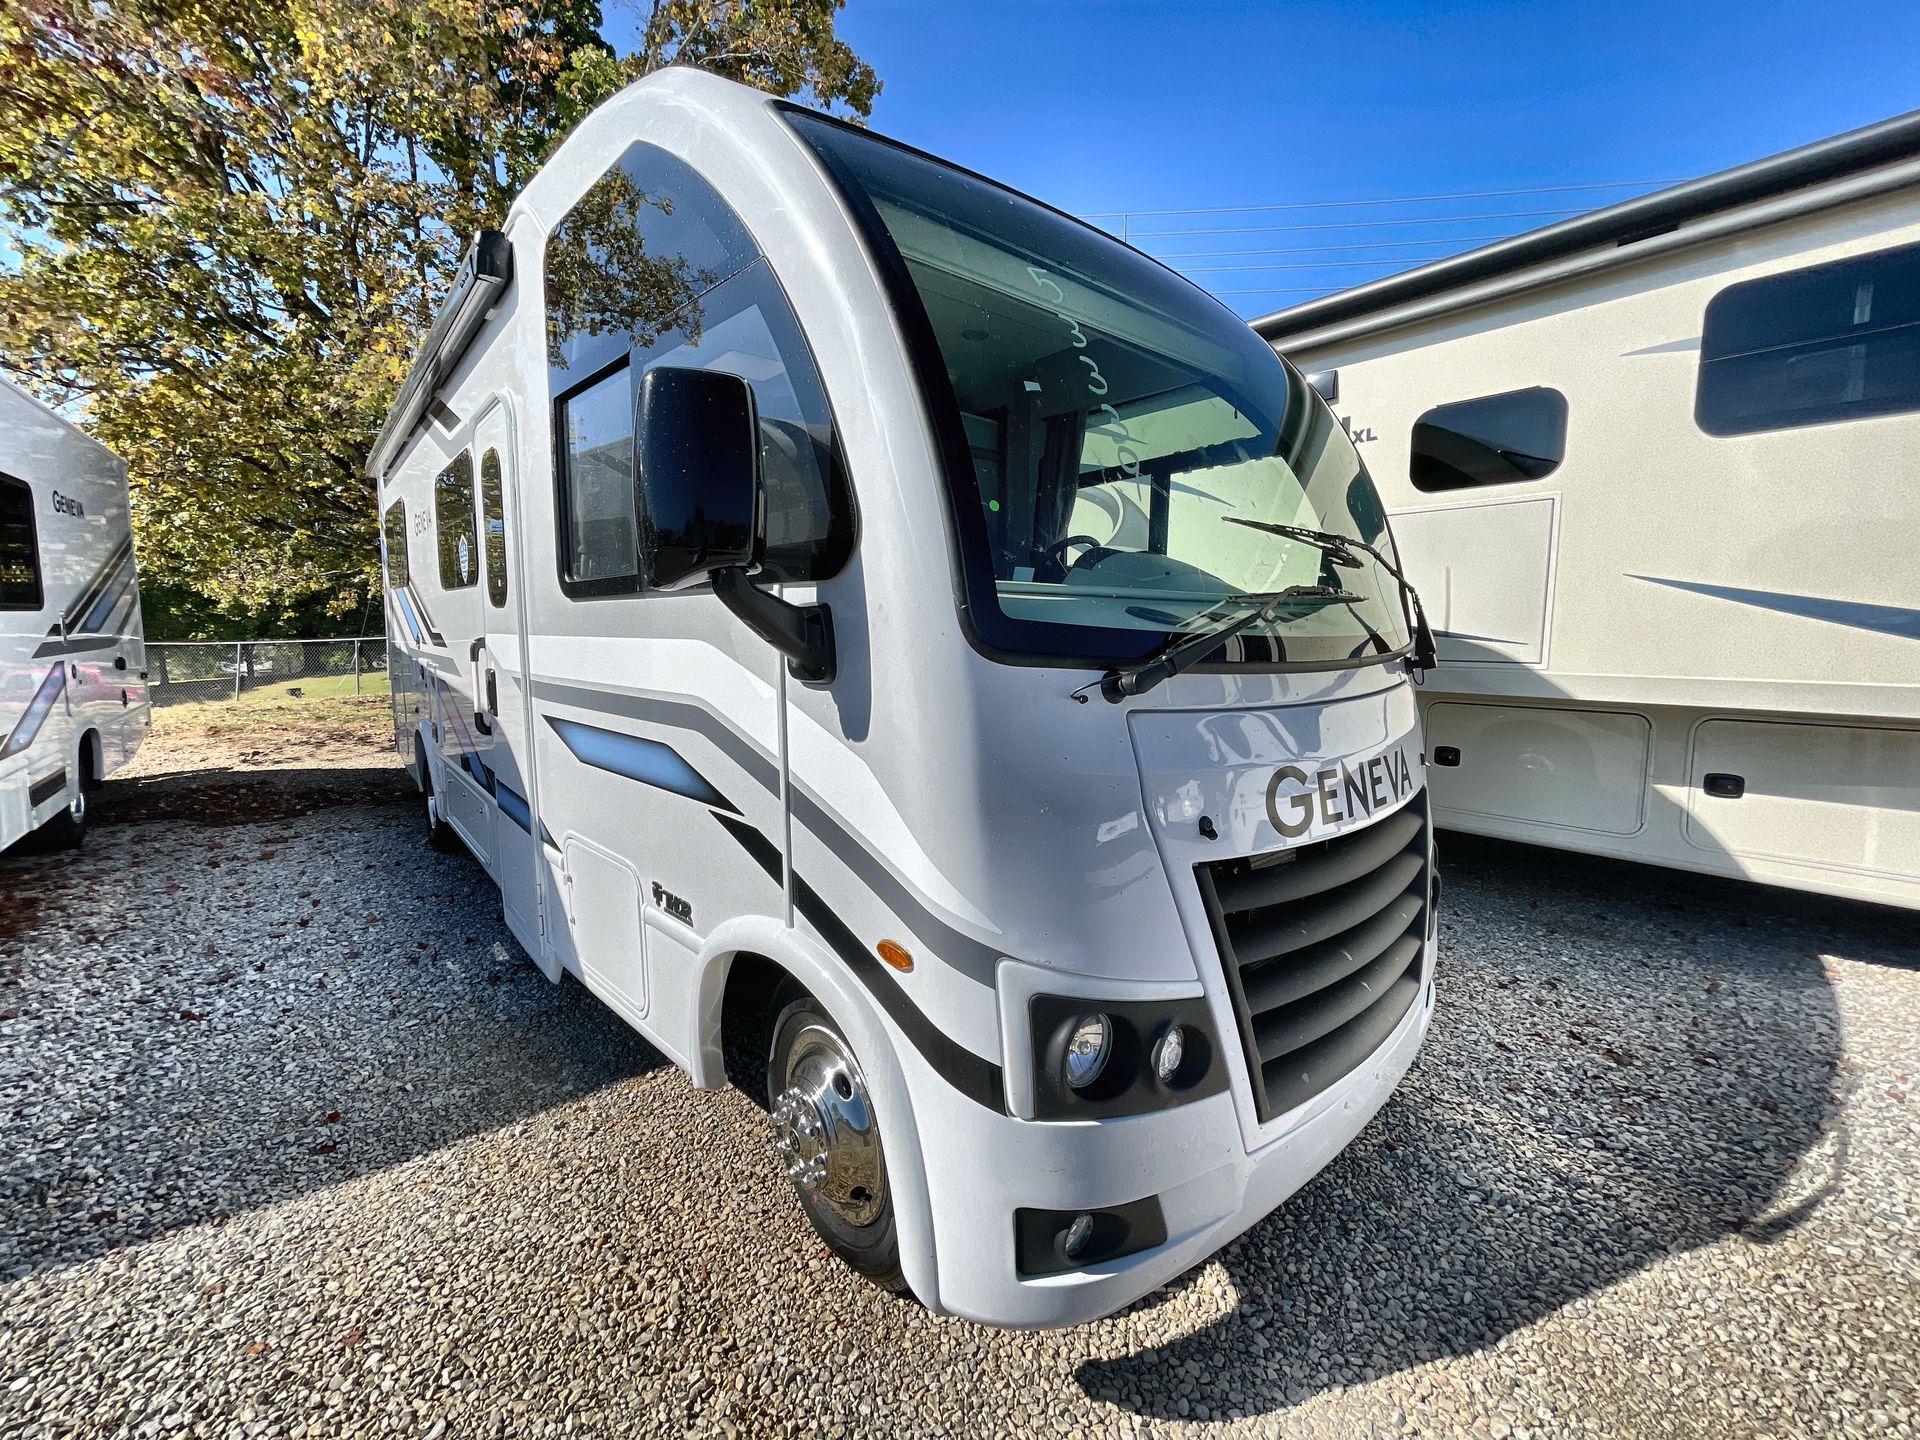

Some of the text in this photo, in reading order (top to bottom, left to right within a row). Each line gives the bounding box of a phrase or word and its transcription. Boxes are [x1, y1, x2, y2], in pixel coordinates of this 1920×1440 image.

[1351, 427, 1378, 444] XL
[51, 489, 86, 519] GENEVA
[1265, 744, 1413, 838] GENEVA
[662, 889, 693, 922] THOR
